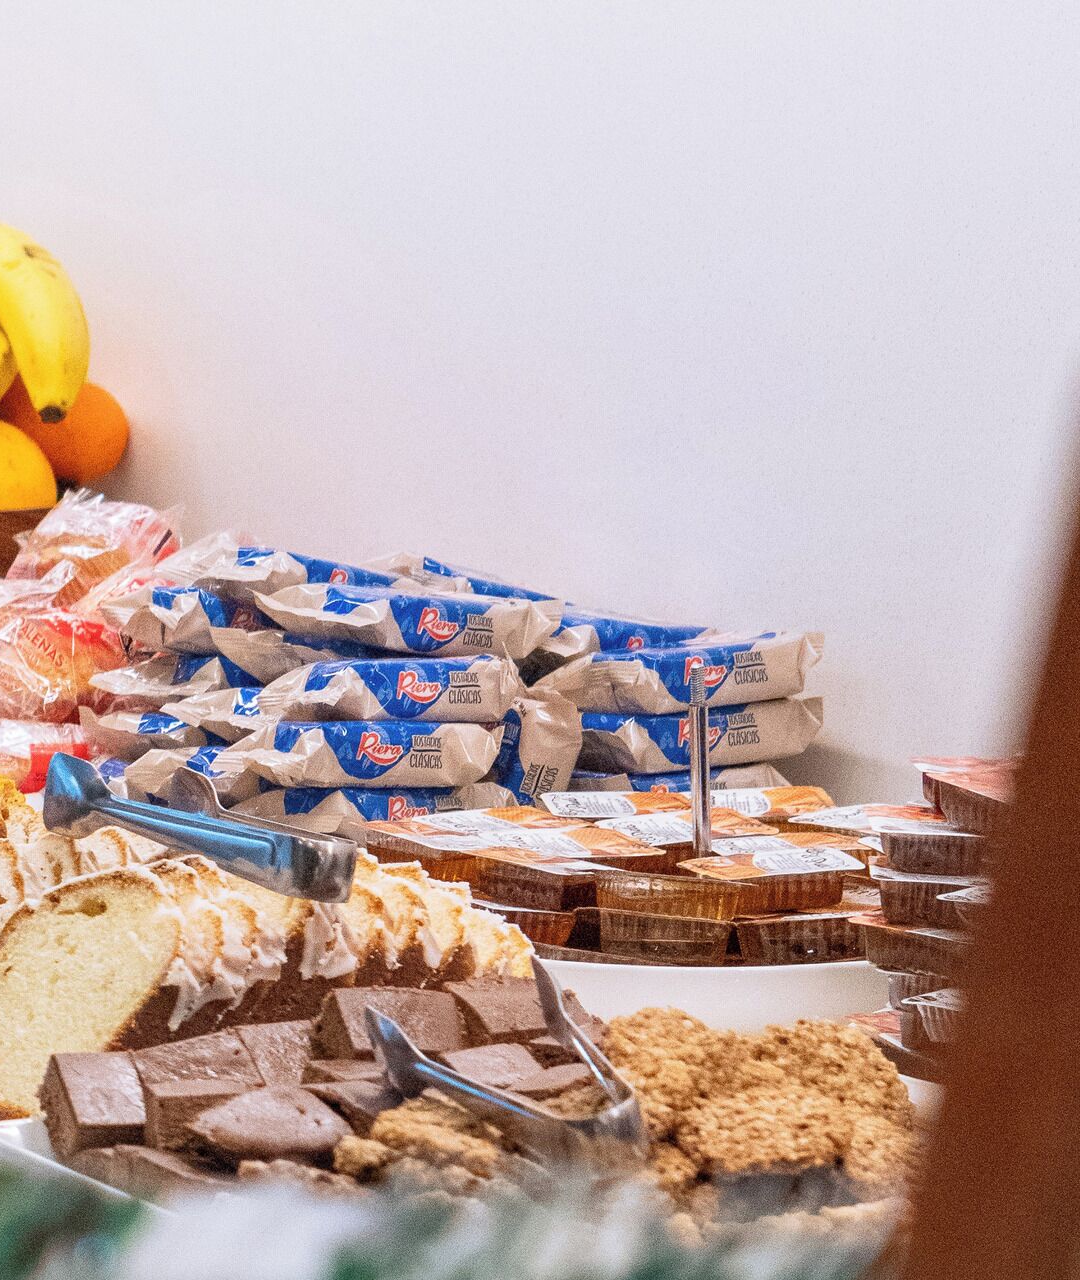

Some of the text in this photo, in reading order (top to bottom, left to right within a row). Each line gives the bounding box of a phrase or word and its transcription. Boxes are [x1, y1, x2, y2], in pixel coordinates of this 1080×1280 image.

[417, 608, 458, 640] Riera
[397, 671, 441, 703] Riera
[448, 687, 482, 704] CLÁSICAS
[356, 732, 403, 765] Riera
[412, 735, 442, 748] TOSTADAS
[409, 752, 442, 769] CLÁSICAS
[389, 796, 428, 821] Riera
